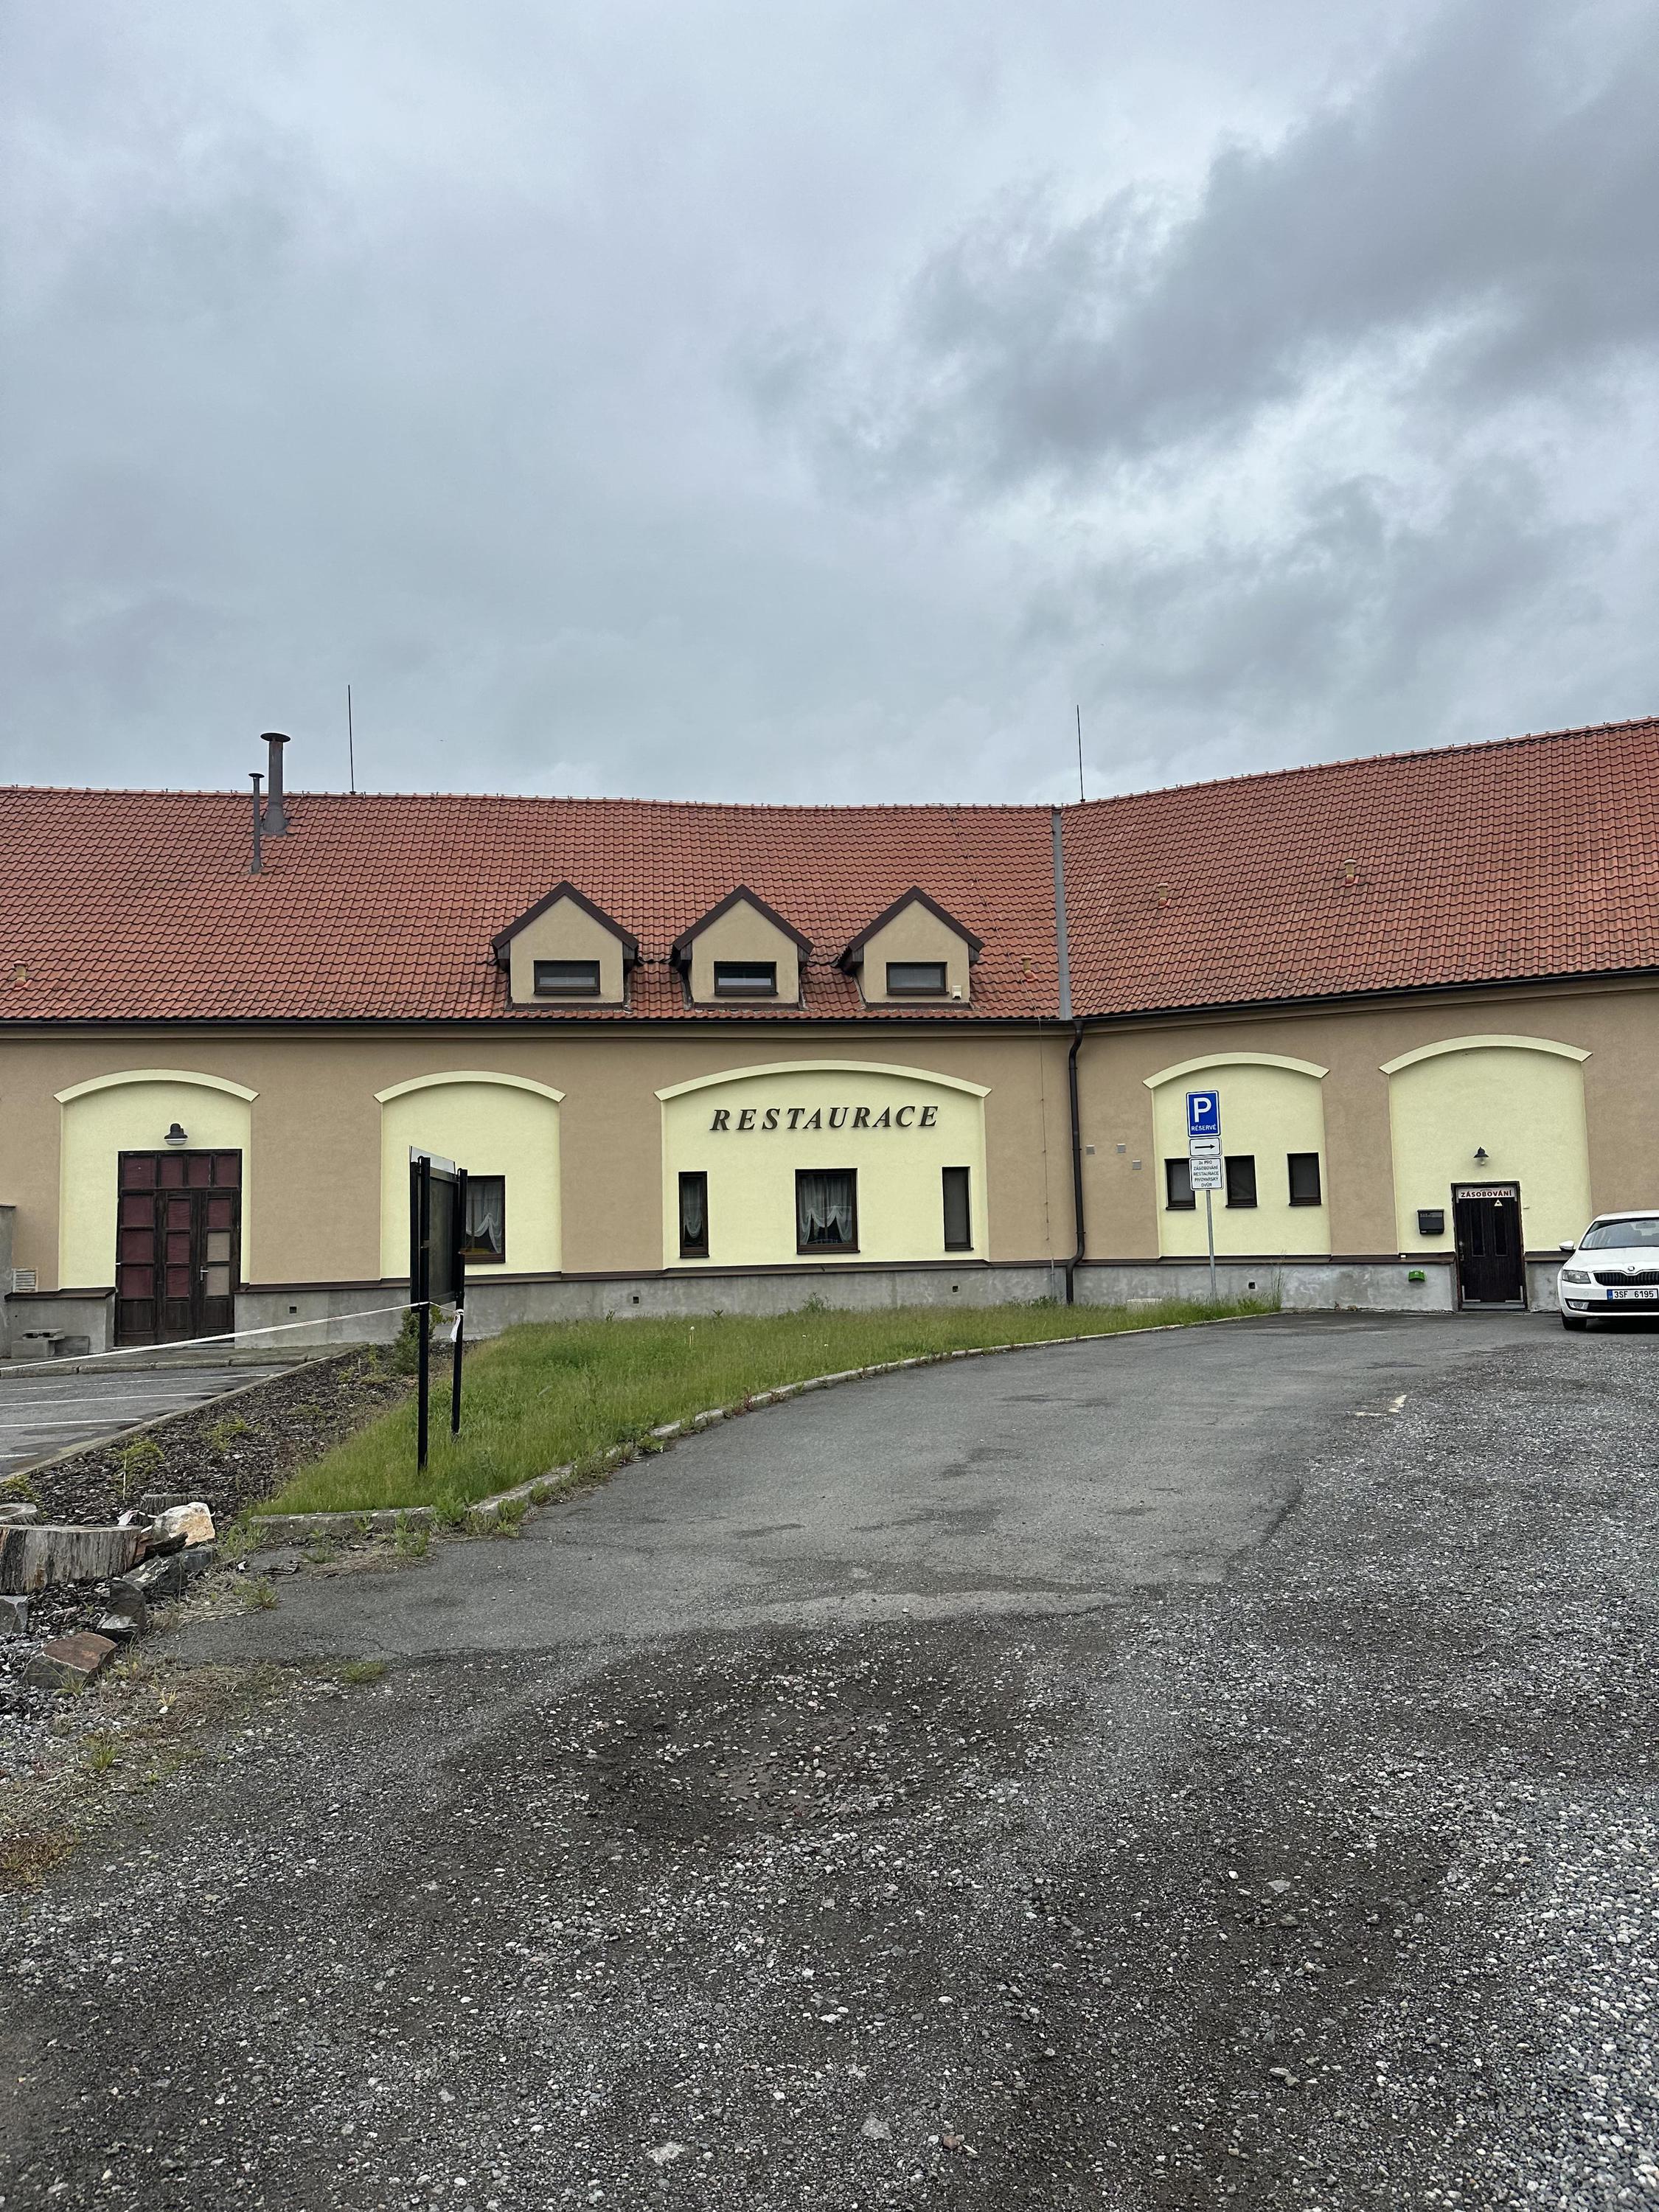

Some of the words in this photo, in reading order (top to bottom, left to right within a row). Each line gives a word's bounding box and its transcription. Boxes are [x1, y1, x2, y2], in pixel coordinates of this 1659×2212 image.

[709, 1106, 939, 1130] RESTAURACE
[1194, 1097, 1211, 1122] P
[1614, 1290, 1628, 1298] 3SF
